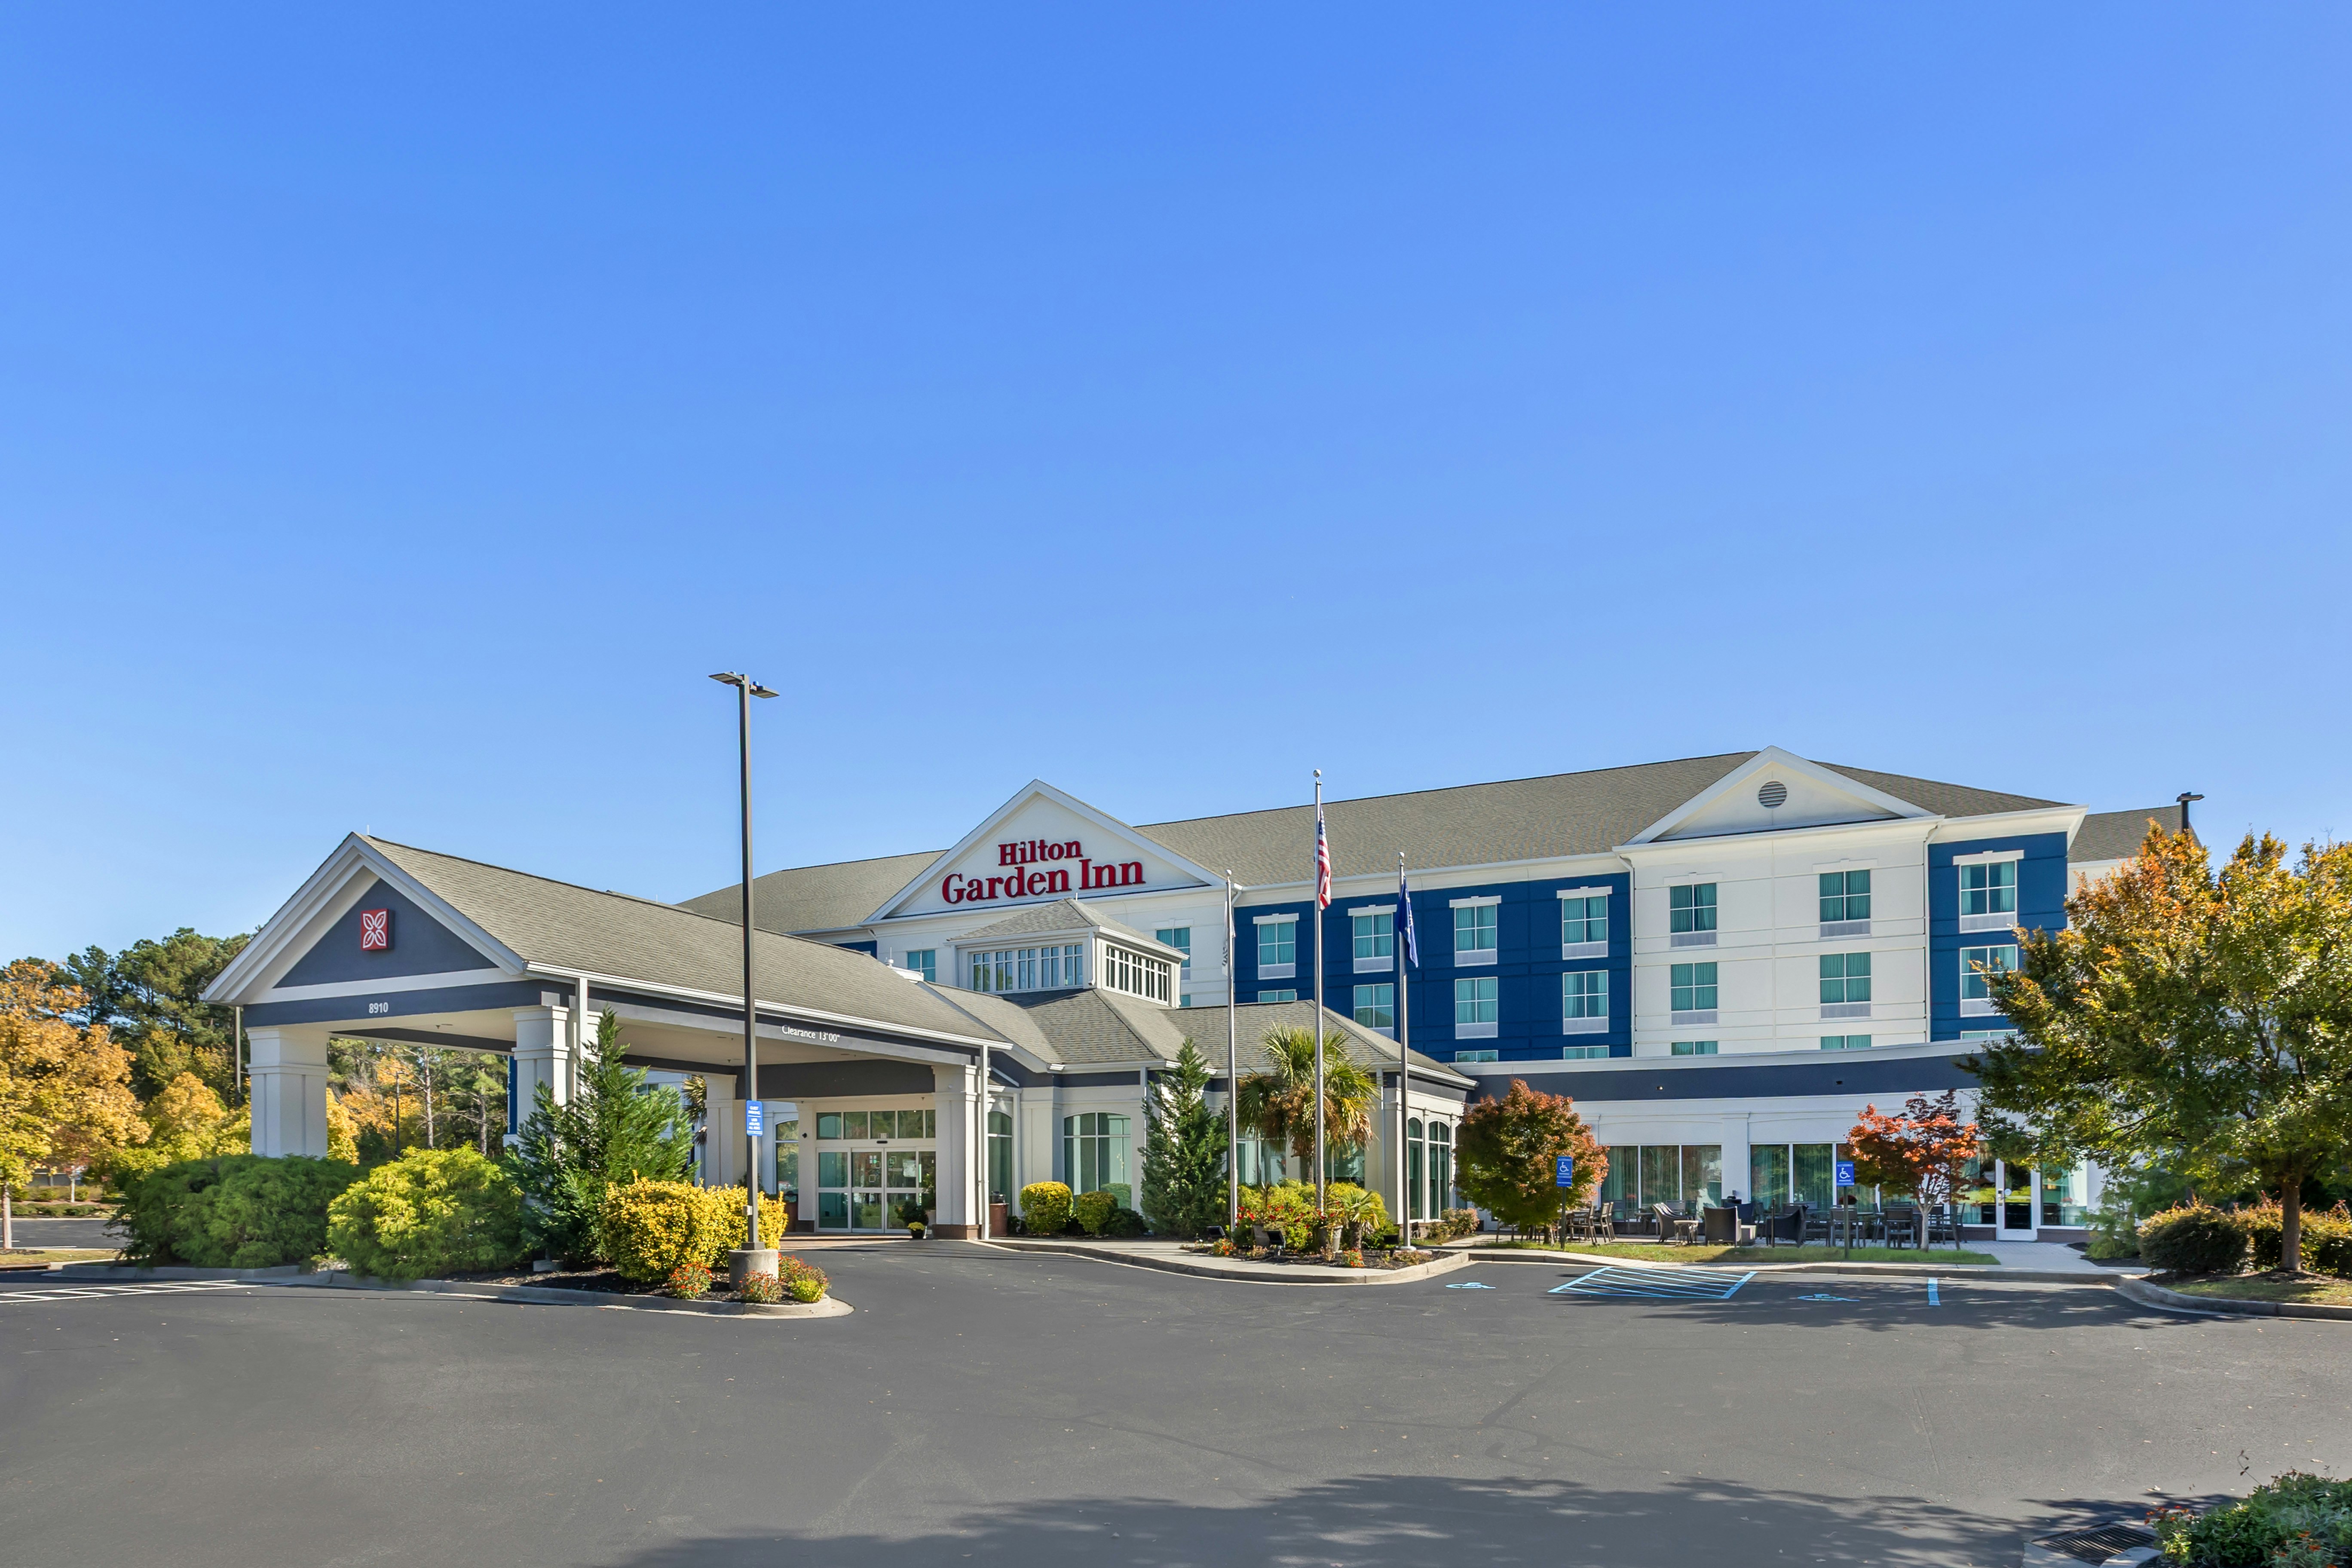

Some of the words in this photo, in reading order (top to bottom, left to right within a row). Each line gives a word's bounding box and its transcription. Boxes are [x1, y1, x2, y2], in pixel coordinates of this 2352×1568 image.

[998, 839, 1083, 866] Hilton
[942, 866, 1072, 904] Garden
[1078, 858, 1145, 890] Inn
[369, 1002, 388, 1014] 8910
[782, 1025, 816, 1039] Clearance
